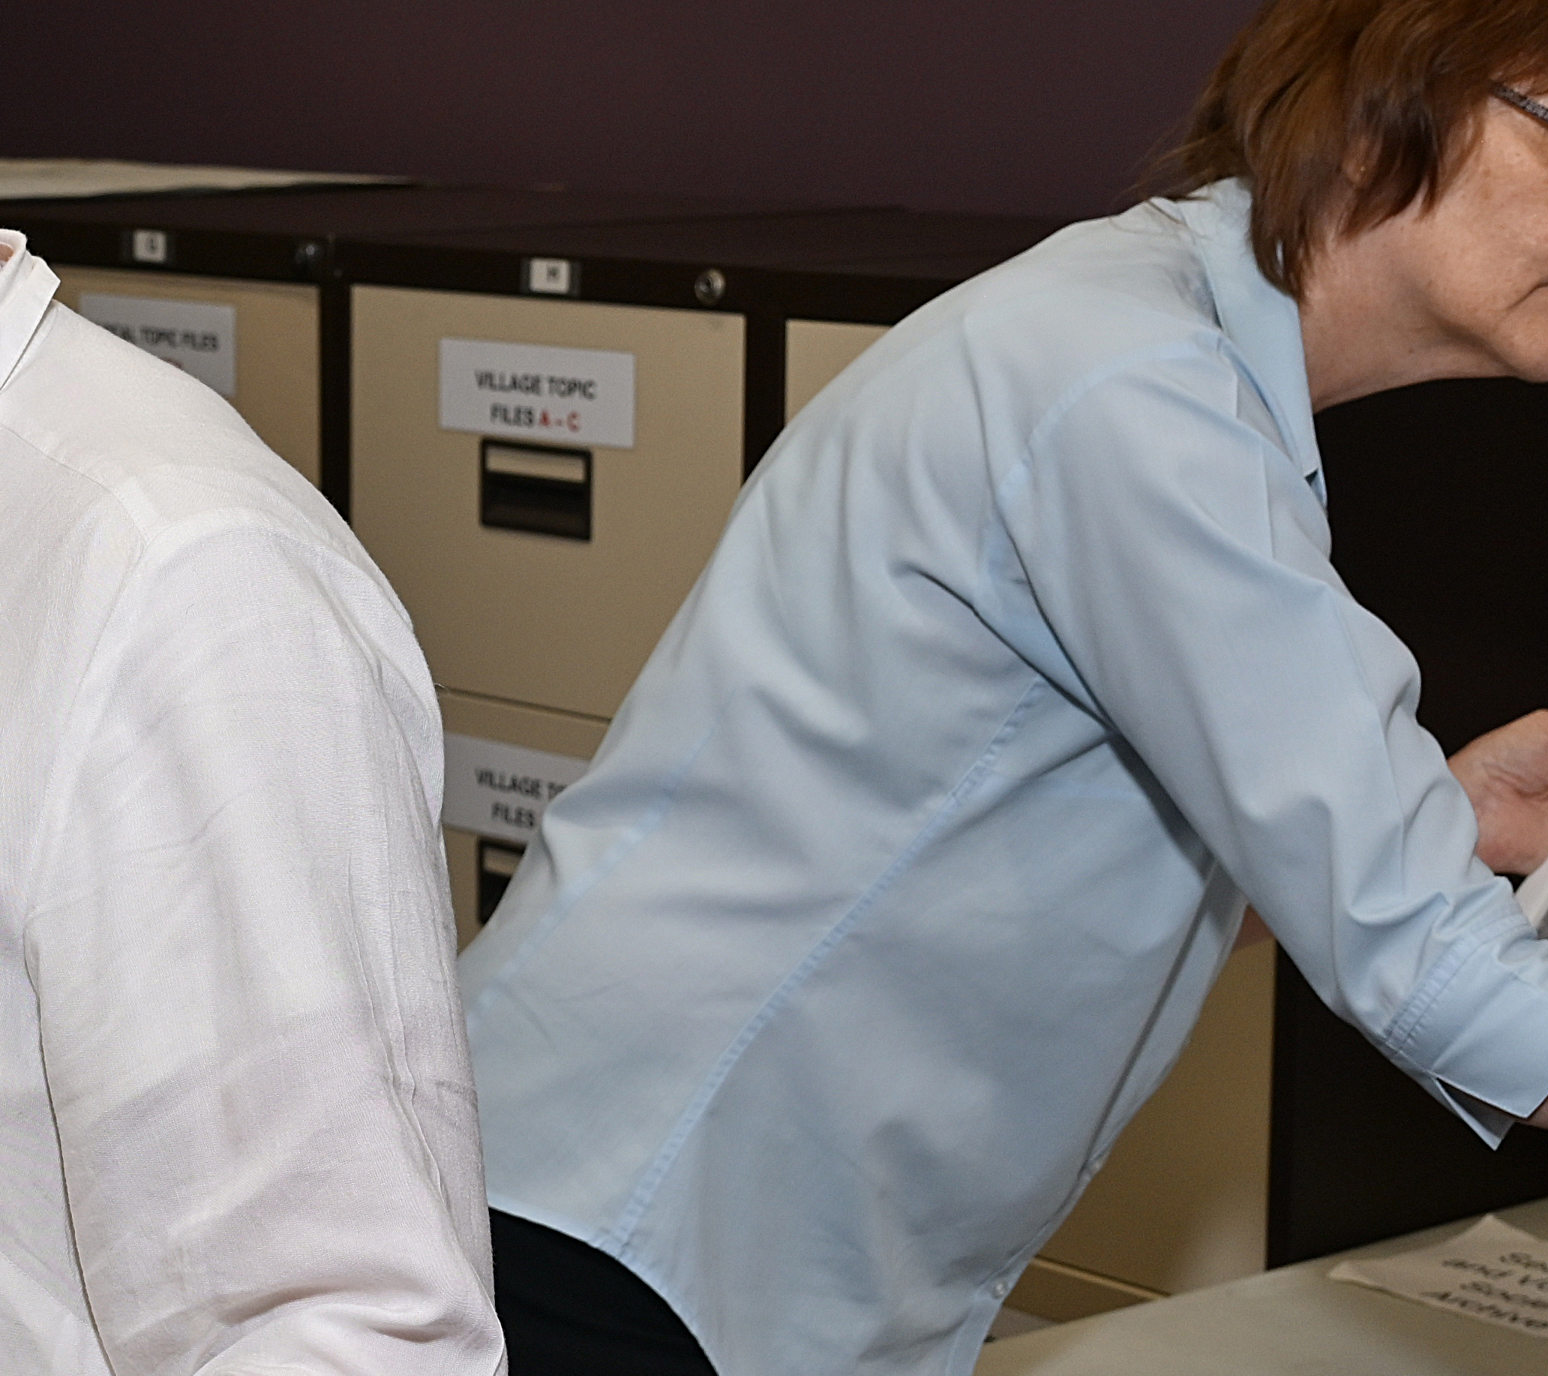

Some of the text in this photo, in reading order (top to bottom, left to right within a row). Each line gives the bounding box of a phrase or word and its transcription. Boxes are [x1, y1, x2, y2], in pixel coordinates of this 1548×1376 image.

[474, 370, 596, 401] VILLAGE TOPIC
[491, 405, 580, 431] FILES A C
